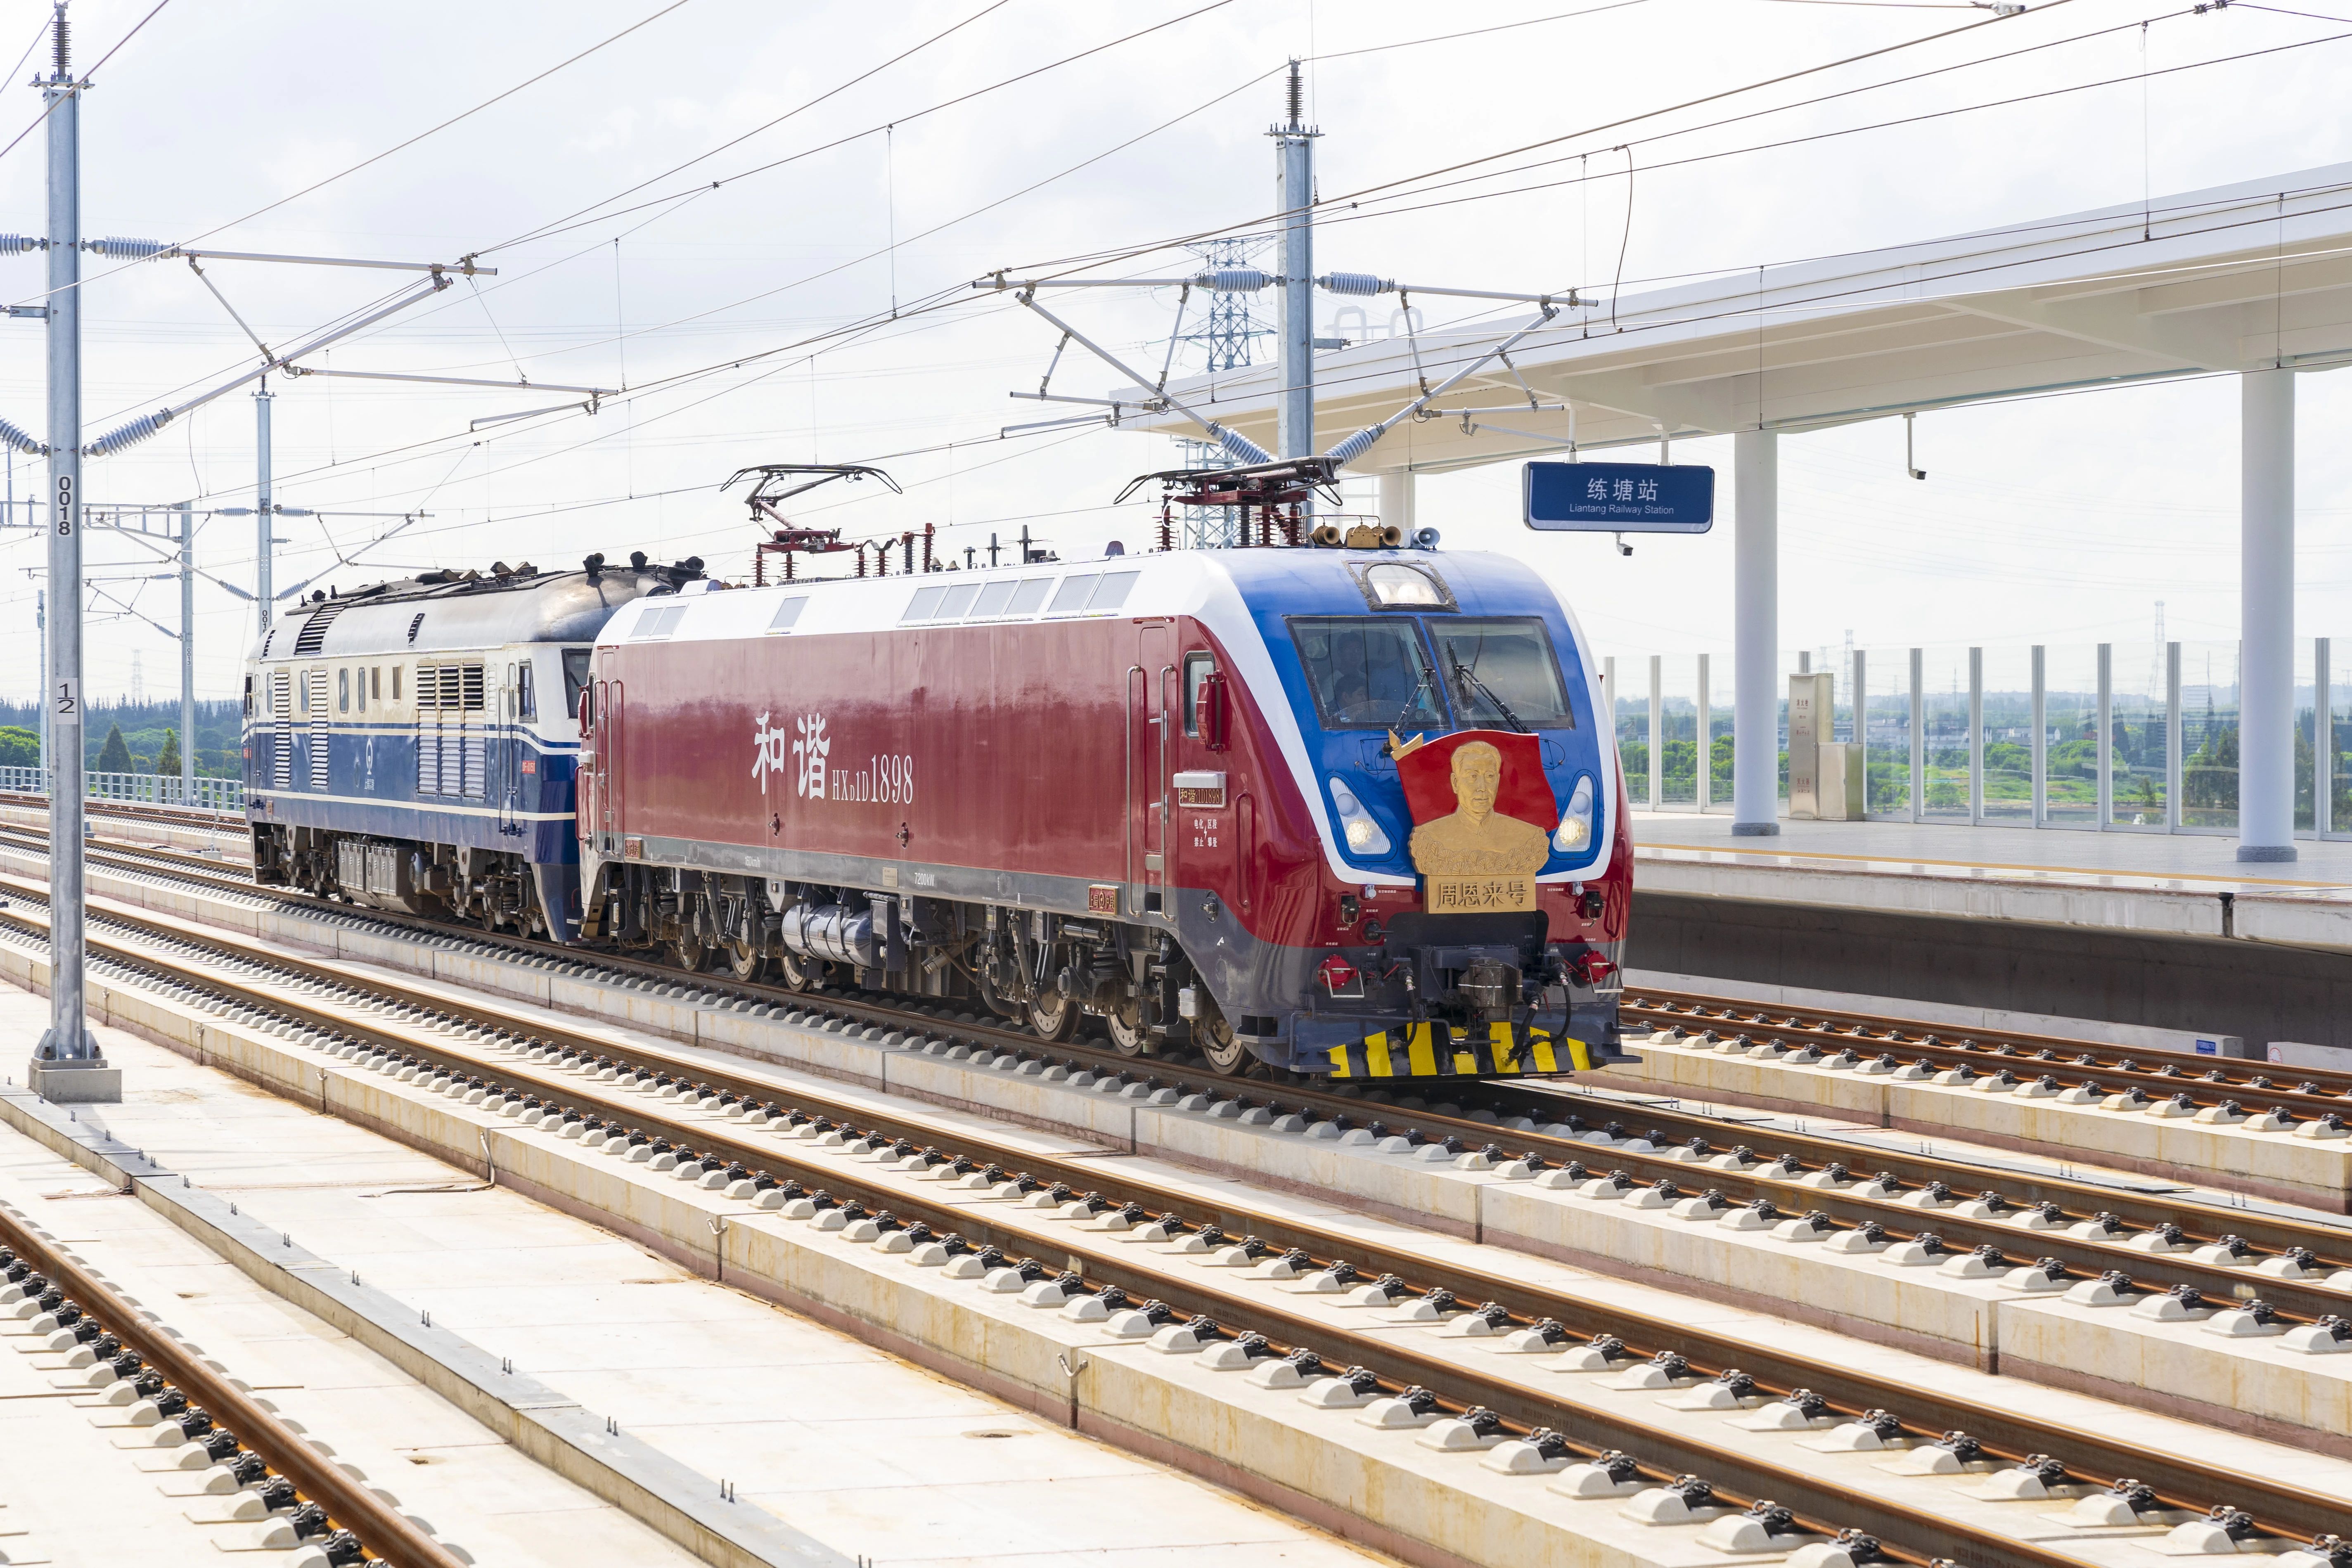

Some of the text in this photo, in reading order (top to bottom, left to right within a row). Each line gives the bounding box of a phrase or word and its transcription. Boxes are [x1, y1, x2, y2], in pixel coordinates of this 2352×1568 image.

[1587, 478, 1658, 502] 练塘站
[58, 476, 71, 536] 0018
[1569, 504, 1674, 516] Liantang Railway Station
[751, 711, 831, 800] 和谐
[914, 872, 935, 886] 7200kW
[1437, 881, 1528, 909] 周恩来号
